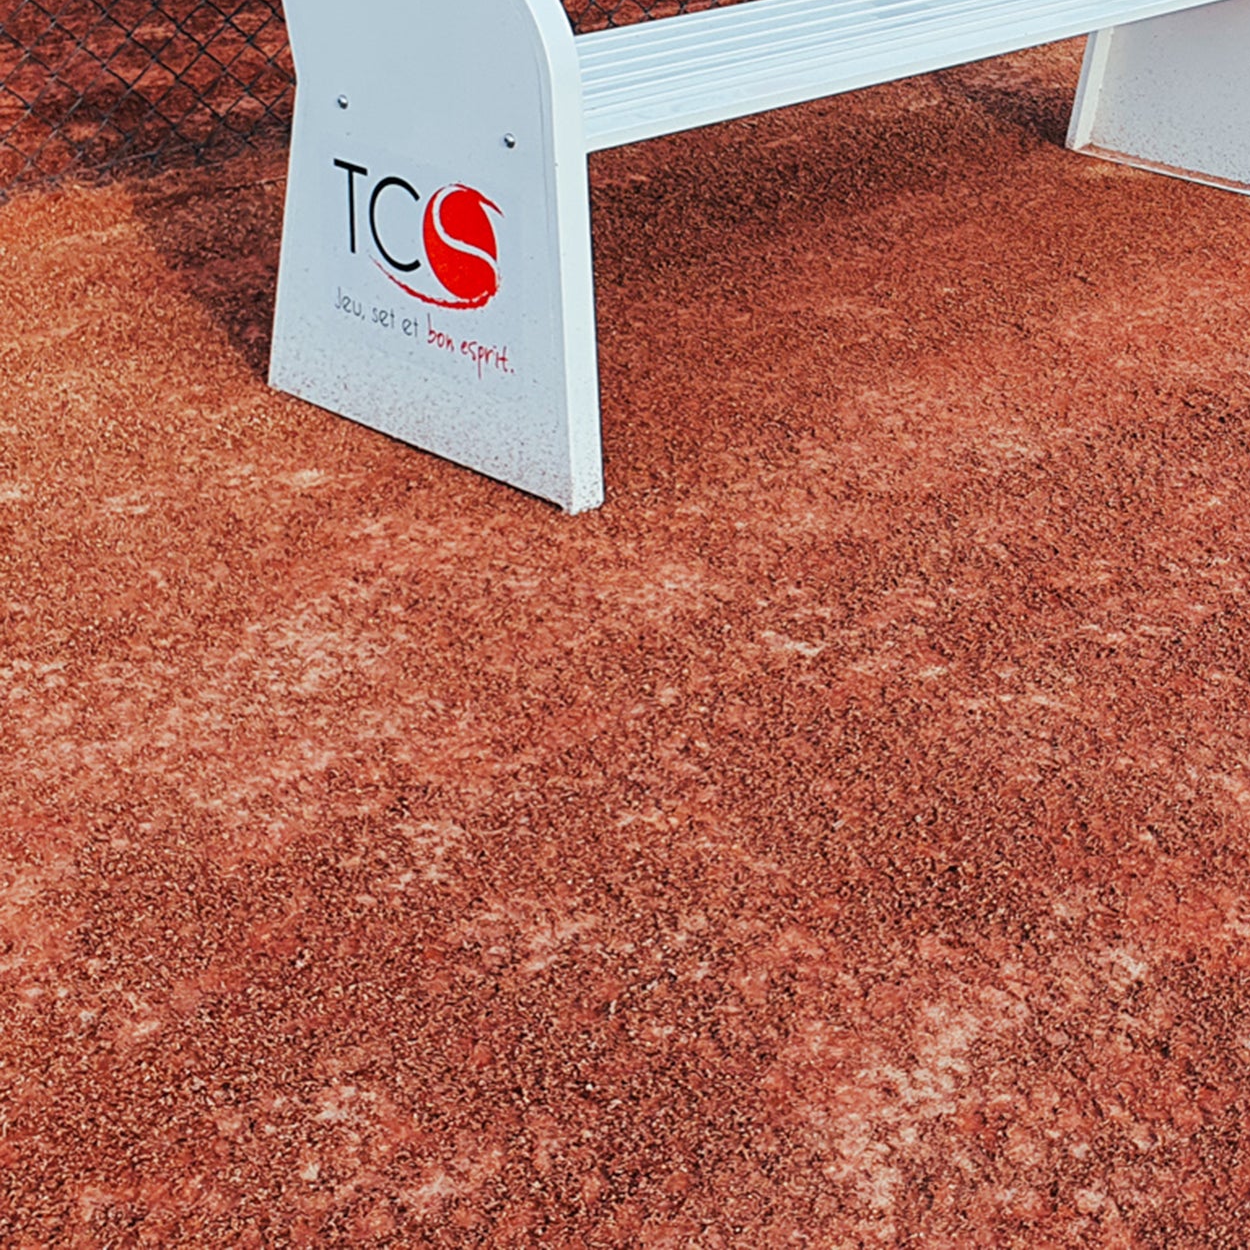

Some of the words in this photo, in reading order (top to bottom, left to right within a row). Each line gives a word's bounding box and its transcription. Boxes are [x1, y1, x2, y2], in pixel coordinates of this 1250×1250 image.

[372, 306, 395, 329] set
[402, 318, 419, 338] et
[427, 312, 455, 352] bon
[461, 340, 515, 380] esprit.
